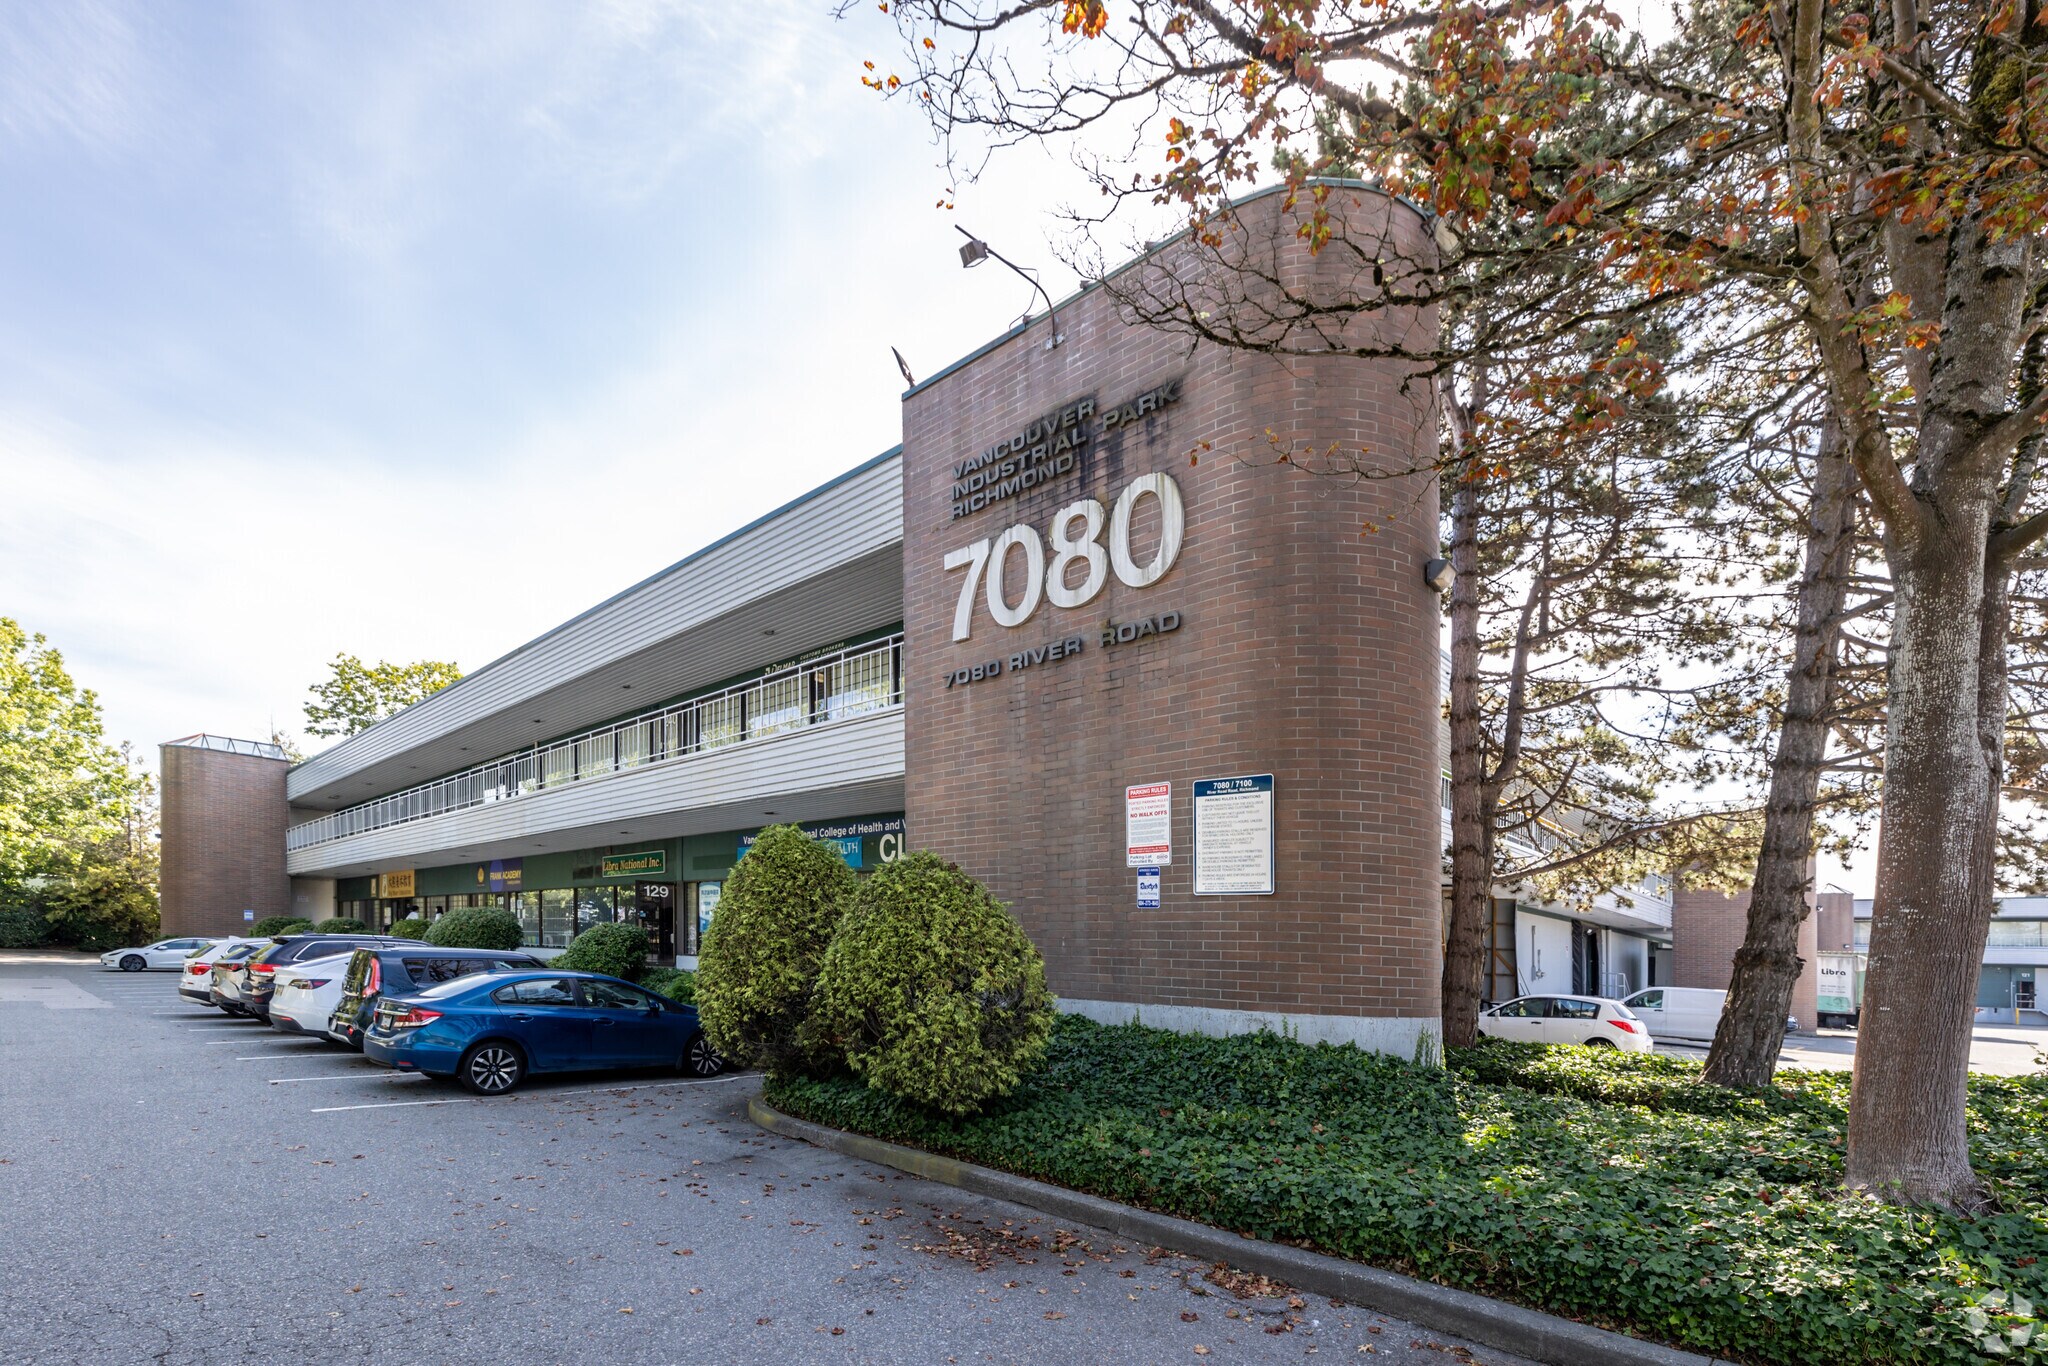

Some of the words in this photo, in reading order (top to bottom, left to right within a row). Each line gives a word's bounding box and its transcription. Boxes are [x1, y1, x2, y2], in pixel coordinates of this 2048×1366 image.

[951, 427, 1087, 500] INDUSTRIAL
[1102, 382, 1180, 431] PARK
[953, 399, 1096, 480] VANCOUVER
[951, 455, 1075, 521] RICHMOND
[943, 472, 1185, 643] 7080
[822, 642, 845, 654] BROKERS
[945, 660, 1001, 689] 7080
[1009, 636, 1083, 672] RIVER
[1101, 610, 1181, 648] ROAD
[1213, 782, 1230, 790] 7080
[1235, 780, 1253, 788] 7100
[819, 827, 847, 838] College
[848, 824, 857, 834] of
[858, 821, 884, 834] Health
[884, 819, 900, 830] and
[603, 861, 619, 872] Libra
[620, 857, 648, 870] National
[648, 857, 662, 868] Inc.
[502, 870, 522, 880] ACADEMY
[643, 885, 669, 898] 129
